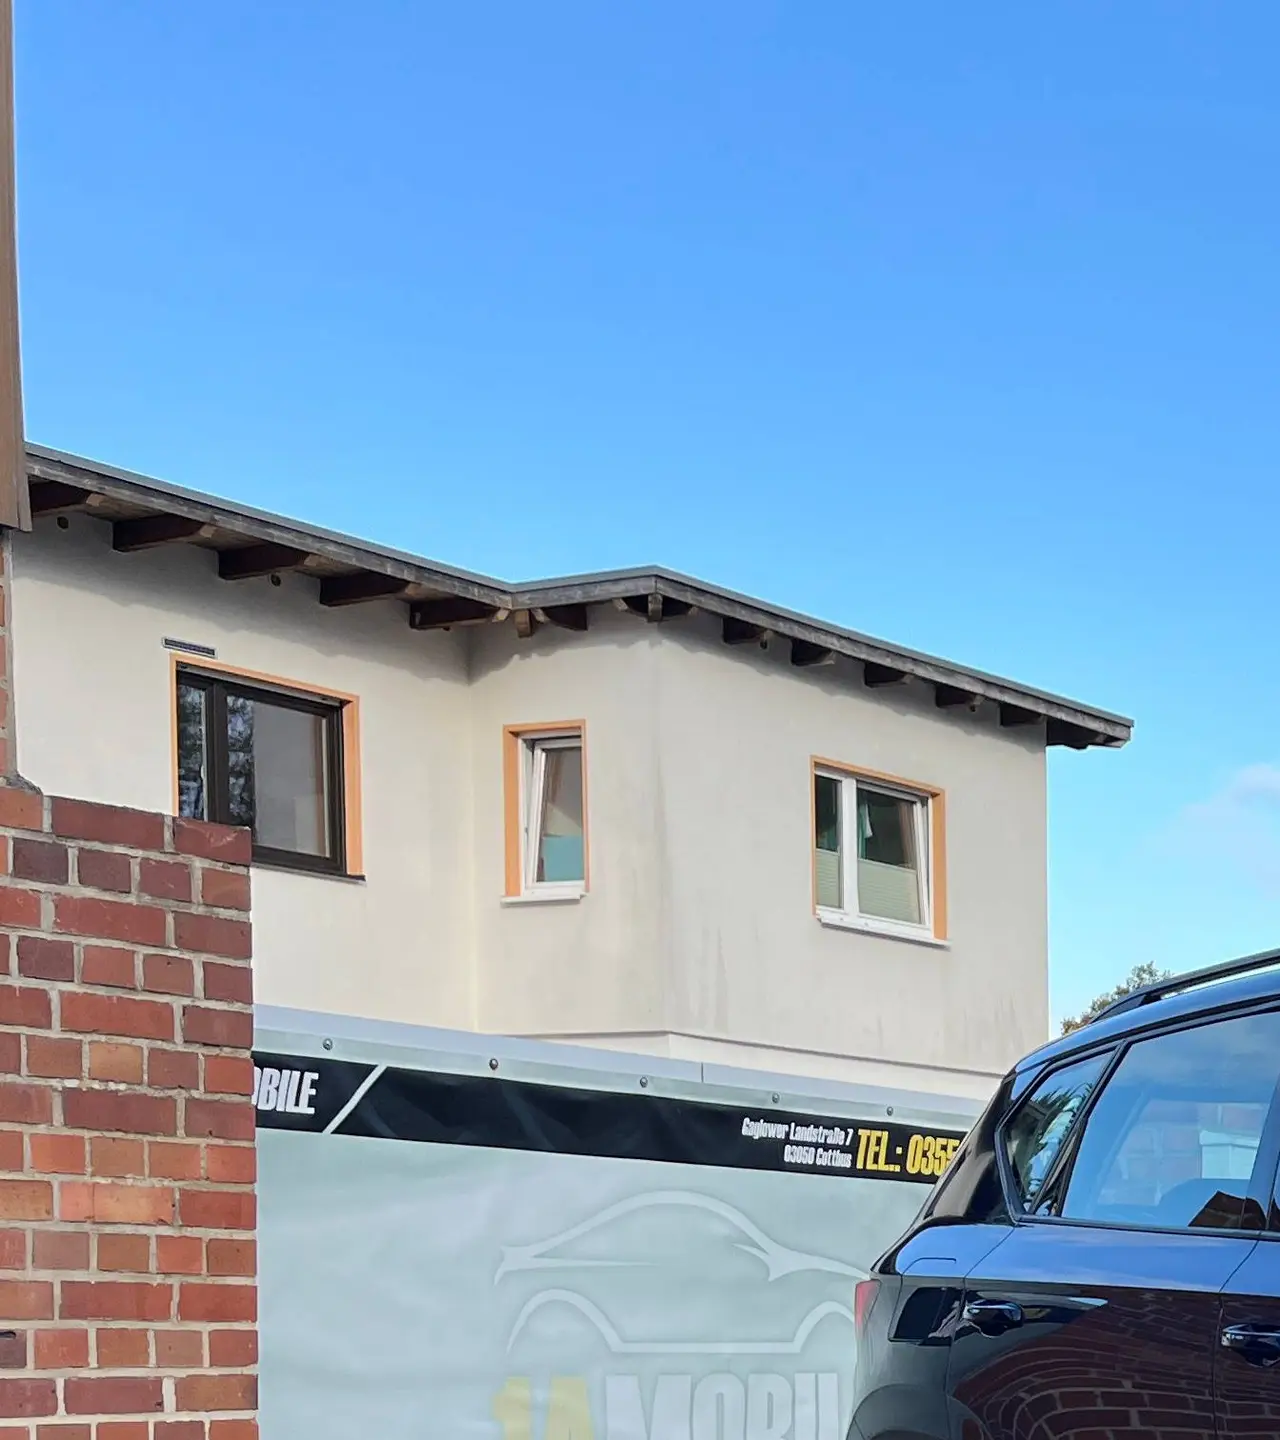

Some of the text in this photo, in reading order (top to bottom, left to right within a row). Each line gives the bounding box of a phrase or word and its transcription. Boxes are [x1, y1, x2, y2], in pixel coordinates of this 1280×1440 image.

[845, 1128, 854, 1146] 7
[815, 1147, 853, 1169] Cottbus
[856, 1128, 902, 1173] TEL.:
